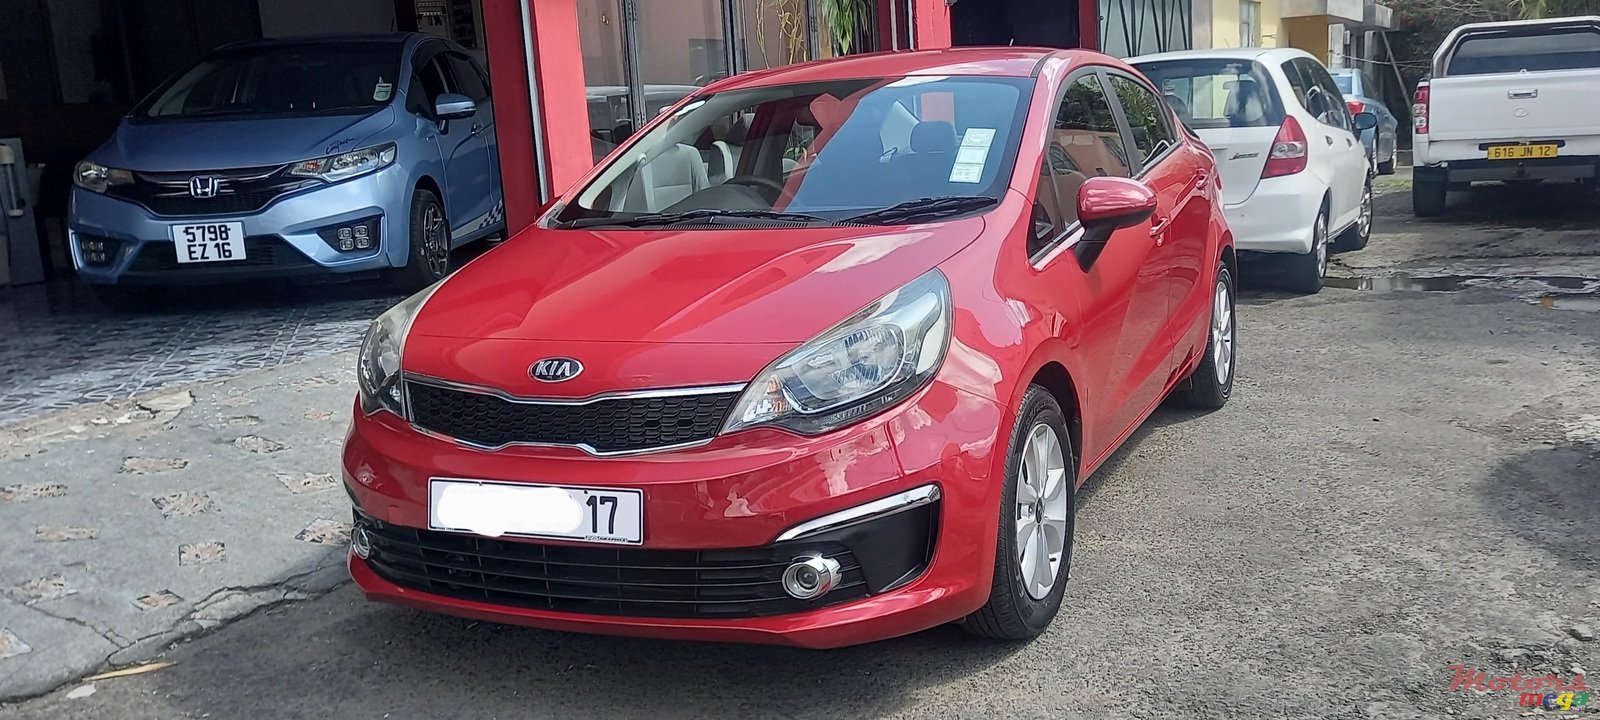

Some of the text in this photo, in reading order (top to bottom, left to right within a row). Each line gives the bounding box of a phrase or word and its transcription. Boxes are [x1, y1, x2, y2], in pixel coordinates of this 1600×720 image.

[1494, 146, 1551, 158] 616 JN 12
[184, 224, 229, 243] 5798
[187, 242, 232, 260] EZ 16
[535, 361, 571, 376] KIA
[586, 495, 617, 534] 17
